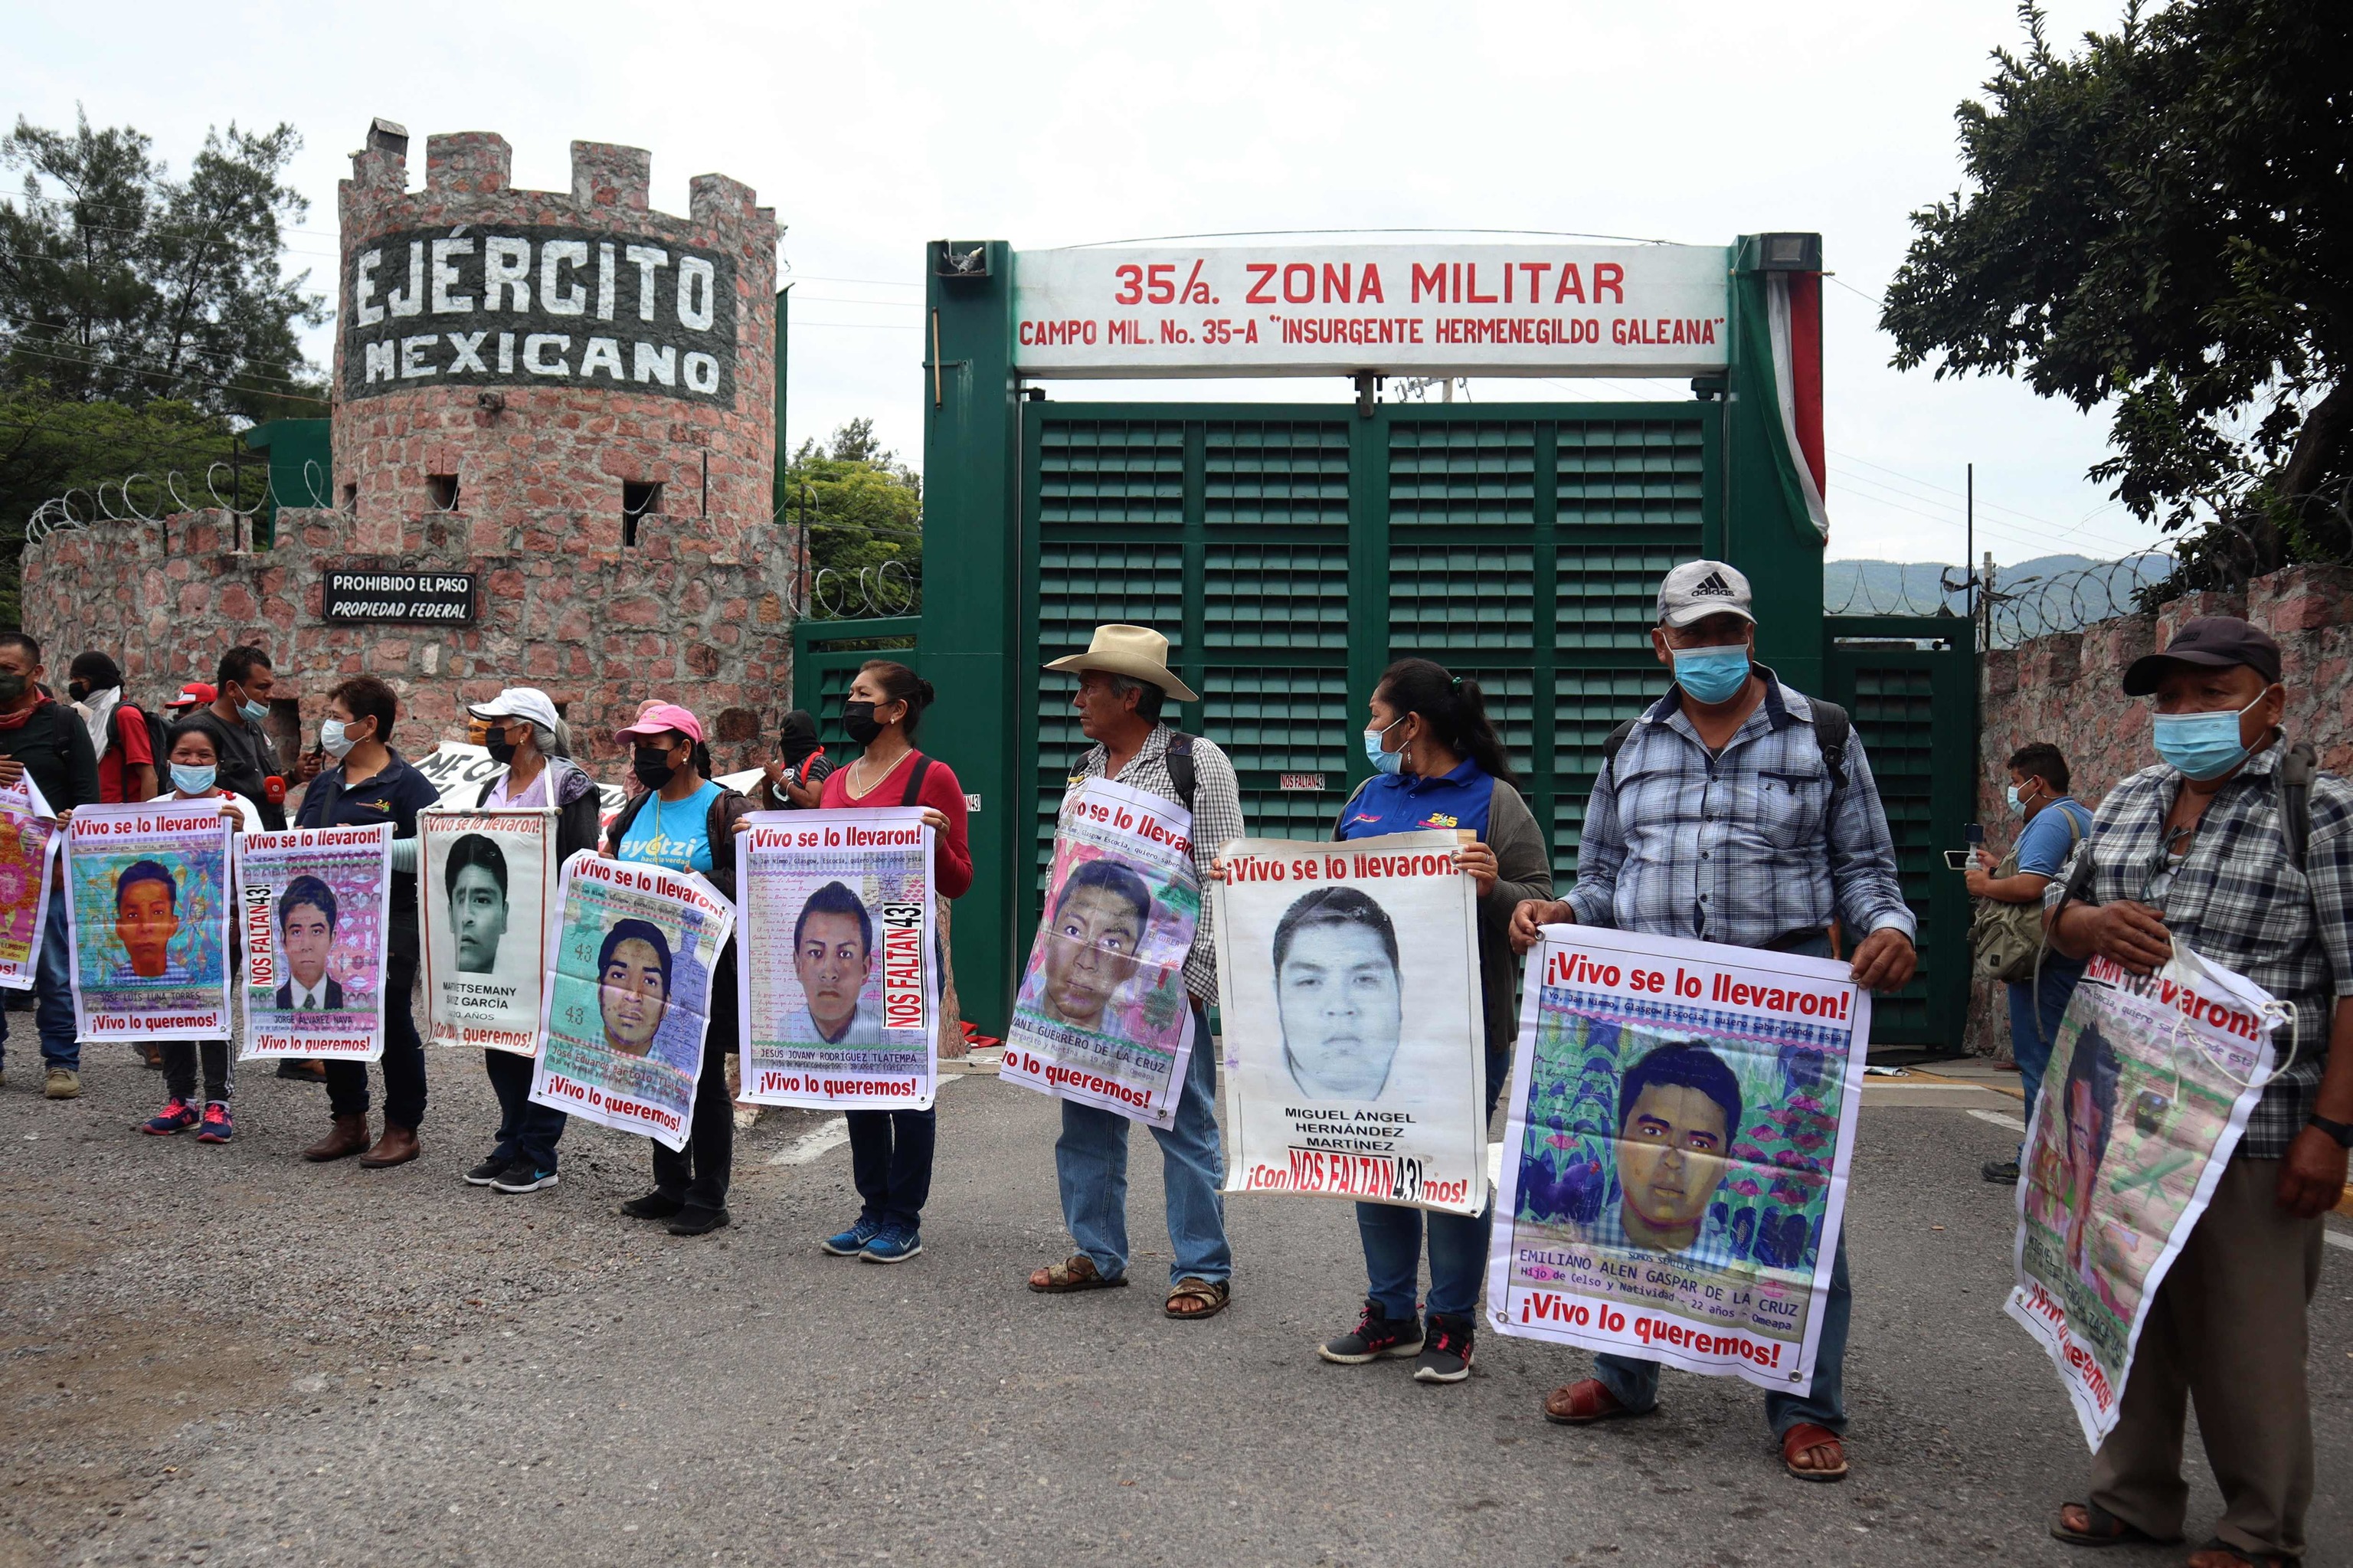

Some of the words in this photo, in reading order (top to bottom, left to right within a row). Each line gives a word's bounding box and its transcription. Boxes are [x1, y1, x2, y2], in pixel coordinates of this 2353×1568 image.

[357, 225, 714, 332] EJÉRCITO
[1246, 263, 1384, 303] ZONA
[1412, 263, 1625, 304] MILITAR
[1019, 319, 1097, 345] CAMPO
[1108, 319, 1154, 345] MIL.
[1160, 319, 1195, 344] No.
[1203, 319, 1258, 344] 35-A
[1436, 318, 1599, 345] HERMENEGILDO
[365, 332, 719, 394] MEXICANO
[333, 575, 415, 591] PROHIBIDO
[420, 578, 433, 592] EL
[436, 578, 468, 592] PASO
[1691, 587, 1735, 597] adidas
[332, 601, 406, 617] PROPIEDAD
[409, 603, 466, 618] FEDERAL
[1281, 775, 1293, 788] NOS
[71, 820, 110, 840] ¡Vivo
[114, 821, 132, 833] se
[137, 817, 151, 833] lo
[156, 816, 221, 832] llevaron!
[456, 818, 466, 830] se
[470, 817, 483, 830] lo
[483, 817, 539, 833] llevaron!
[1089, 802, 1108, 823] se
[1114, 807, 1133, 830] lo
[244, 833, 277, 854] ¡Vivo
[281, 835, 296, 848] se
[301, 831, 313, 846] lo
[318, 827, 381, 846] llevaron!
[749, 829, 792, 853] ¡Vivo
[797, 832, 818, 846] se
[824, 827, 842, 847] lo
[846, 825, 921, 846] llevaron!
[1082, 830, 1101, 840] Glasgow
[1134, 847, 1157, 859] quiero
[1160, 856, 1180, 868] saber
[665, 857, 690, 866] verdad
[794, 857, 819, 866] Glasgow,
[850, 857, 869, 866] quiero
[1226, 855, 1285, 885] ¡Vivo
[1293, 859, 1317, 880] se
[1325, 854, 1347, 879] lo
[1354, 850, 1459, 879] llevaron!
[574, 858, 610, 880] ¡Vivo
[615, 870, 633, 886] se
[637, 872, 651, 891] lo
[656, 876, 723, 919] llevaron!
[0, 941, 28, 952] LUMBRE
[575, 943, 593, 962] 43
[252, 957, 273, 986] NOS
[147, 991, 166, 1001] LUNA
[172, 991, 200, 1000] TORRES
[1547, 951, 1621, 987] ¡Vivo
[1629, 969, 1665, 993] se
[1675, 967, 1702, 998] lo
[1712, 973, 1850, 1020] llevaron!
[461, 997, 509, 1010] GARCÍA
[565, 1006, 584, 1025] 43
[887, 994, 921, 1027] NOS
[2122, 1004, 2153, 1025] quiero
[93, 1015, 125, 1033] ¡Vivo
[129, 1014, 141, 1030] lo
[146, 1012, 216, 1032] queremos!
[274, 1015, 295, 1024] JORGE
[333, 1016, 352, 1024] NAVA
[464, 1012, 495, 1020] AÑOS
[1549, 991, 1563, 1002] Yo,
[1569, 995, 1583, 1003] Jan
[1625, 1003, 1662, 1015] Glasgow
[1667, 1008, 1707, 1023] Escocia,
[1714, 1016, 1748, 1027] quiero
[1753, 1022, 1781, 1032] saber
[1819, 1031, 1842, 1042] está
[256, 1035, 286, 1052] ¡Vivo
[290, 1036, 301, 1050] lo
[306, 1036, 370, 1053] queremos!
[463, 1027, 532, 1049] queremos!
[1010, 1030, 1042, 1045] Margarito
[1038, 1026, 1089, 1049] GUERRERO
[1095, 1043, 1108, 1056] DE
[1117, 1050, 1129, 1062] LA
[1136, 1057, 1165, 1073] CRUZ
[552, 1046, 572, 1059] José
[575, 1052, 610, 1071] Eduardo
[612, 1065, 653, 1082] Bartolo
[761, 1049, 784, 1058] JESÚS
[788, 1050, 815, 1060] JOVANY
[820, 1050, 867, 1062] RODRÍGUEZ
[872, 1053, 917, 1062] TLATEMPA
[760, 1072, 800, 1094] ¡Vivo
[804, 1074, 820, 1092] lo
[823, 1078, 917, 1098] queremos!
[1023, 1052, 1040, 1074] lo
[1046, 1066, 1152, 1109] queremos!
[548, 1075, 584, 1100] ¡Vivo
[588, 1087, 601, 1105] lo
[604, 1097, 681, 1132] queremos!
[1285, 1108, 1350, 1121] MIGUEL
[1354, 1109, 1417, 1124] ÁNGEL
[1296, 1122, 1405, 1138] HERNÁNDEZ
[1307, 1137, 1396, 1151] MARTÍNEZ
[1287, 1150, 1324, 1191] NOS
[1628, 1252, 1653, 1263] SOMOS
[1658, 1256, 1694, 1272] SEMILLAS
[2029, 1235, 2055, 1267] MIGUEL
[1520, 1249, 1592, 1270] EMILIANO
[1600, 1262, 1638, 1279] ALEN
[1646, 1270, 1697, 1293] GASPAR
[1706, 1285, 1723, 1301] DE
[1733, 1292, 1750, 1305] LA
[1759, 1299, 1798, 1317] CRUZ
[1521, 1267, 1546, 1280] Hijo
[1553, 1271, 1566, 1280] de
[1571, 1273, 1601, 1287] Celso
[1606, 1282, 1614, 1291] y
[1619, 1283, 1674, 1301] Natividad
[1691, 1299, 1703, 1310] 22
[1709, 1305, 1735, 1318] años
[1752, 1313, 1792, 1331] Omeapa
[1522, 1292, 1589, 1325] ¡Vivo
[1599, 1304, 1625, 1332] lo
[1635, 1316, 1782, 1368] queremos!
